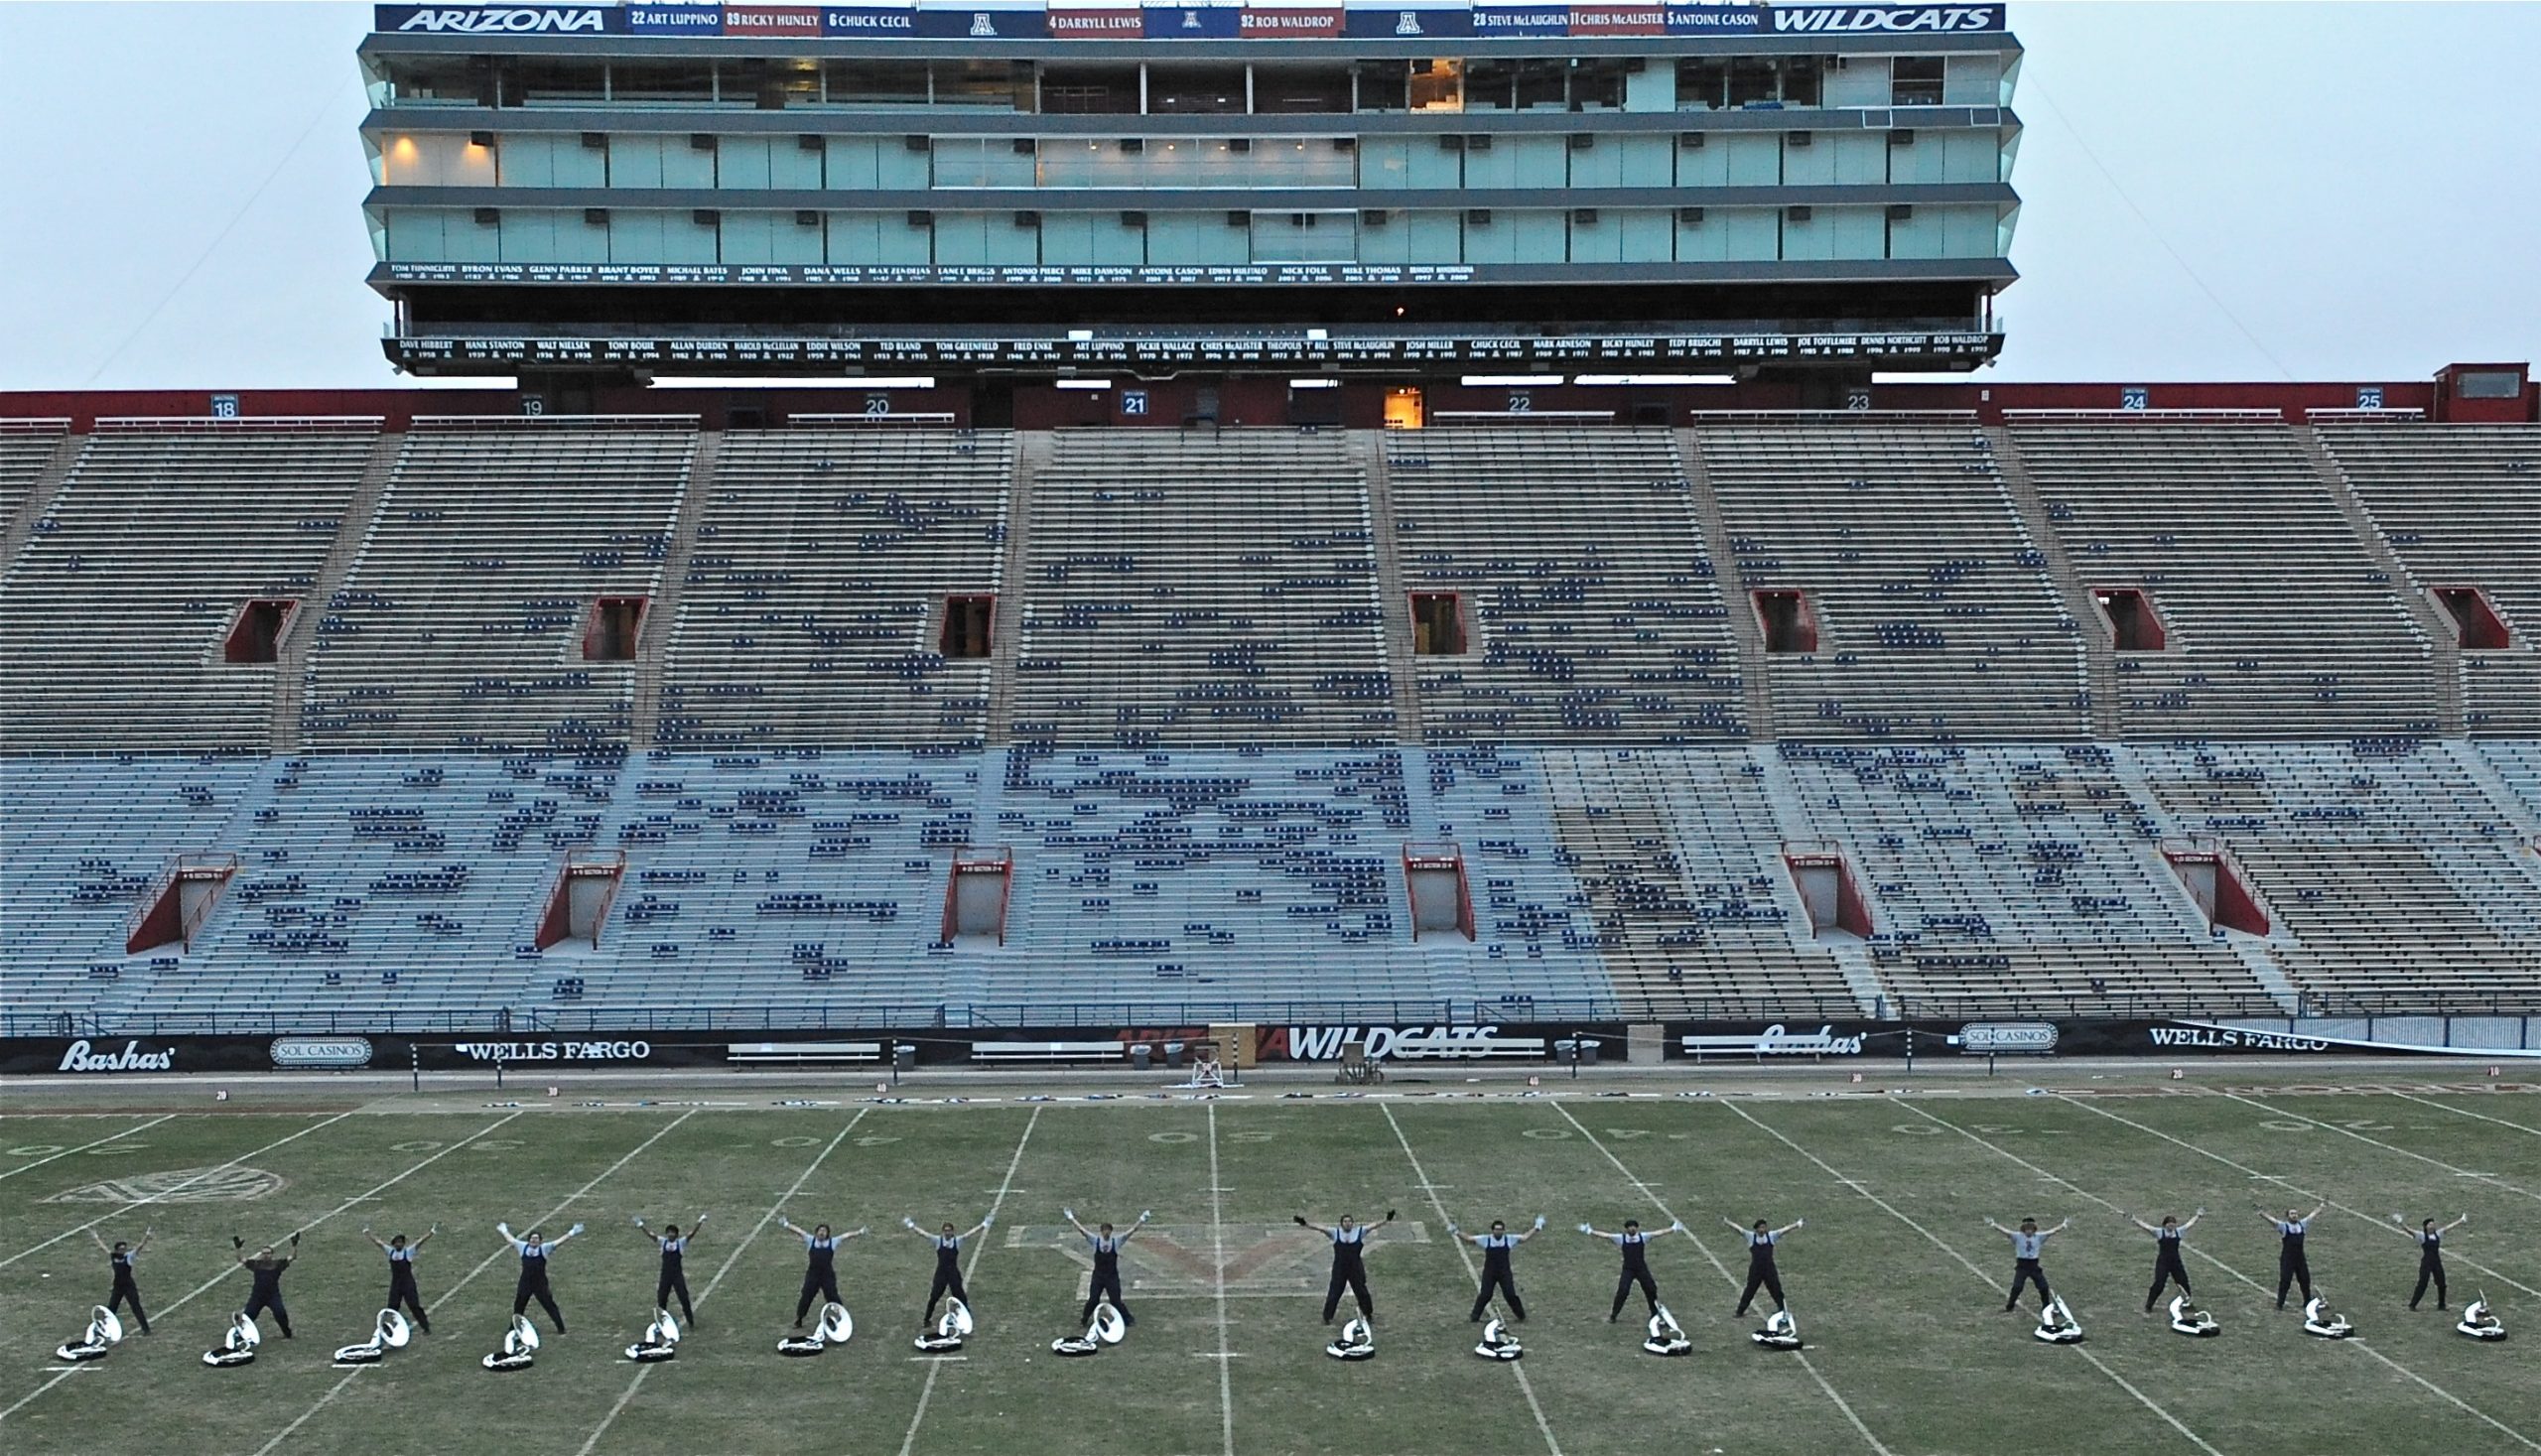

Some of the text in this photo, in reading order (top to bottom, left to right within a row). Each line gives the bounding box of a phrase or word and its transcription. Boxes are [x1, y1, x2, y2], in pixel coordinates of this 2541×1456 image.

[400, 10, 603, 33] ARIZONA
[632, 11, 718, 25] 22 ART LUPPINO
[728, 13, 818, 26] 89 RICKY HUNLEY
[830, 14, 910, 27] 6 CHUCK CECIL
[1050, 16, 1140, 28] 4 DARRYLL LEWIS
[1242, 15, 1333, 27] 92 ROB WALDROP
[1474, 14, 1567, 26] 28 STEVE McLAUGHLIN
[1571, 13, 1664, 25] 11 CHRIS McALISTER
[1669, 12, 1758, 25] 5 ANTOINE CASON
[1775, 9, 1992, 32] WILDCATS
[1799, 337, 1810, 346] JOE
[523, 401, 542, 415] 19
[866, 400, 889, 414] 20
[1126, 398, 1143, 413] 21
[1509, 398, 1530, 411] 22
[1848, 396, 1869, 410] 23
[2124, 395, 2145, 409] 24
[2359, 395, 2380, 409] 25
[215, 403, 234, 417] 18
[1970, 1031, 2048, 1041] SOL CASINOS
[2149, 1028, 2237, 1046] WELLS
[59, 1040, 176, 1071] Bashas'
[281, 1046, 361, 1056] SOL CASINOS
[468, 1041, 650, 1059] WELLS FARGO
